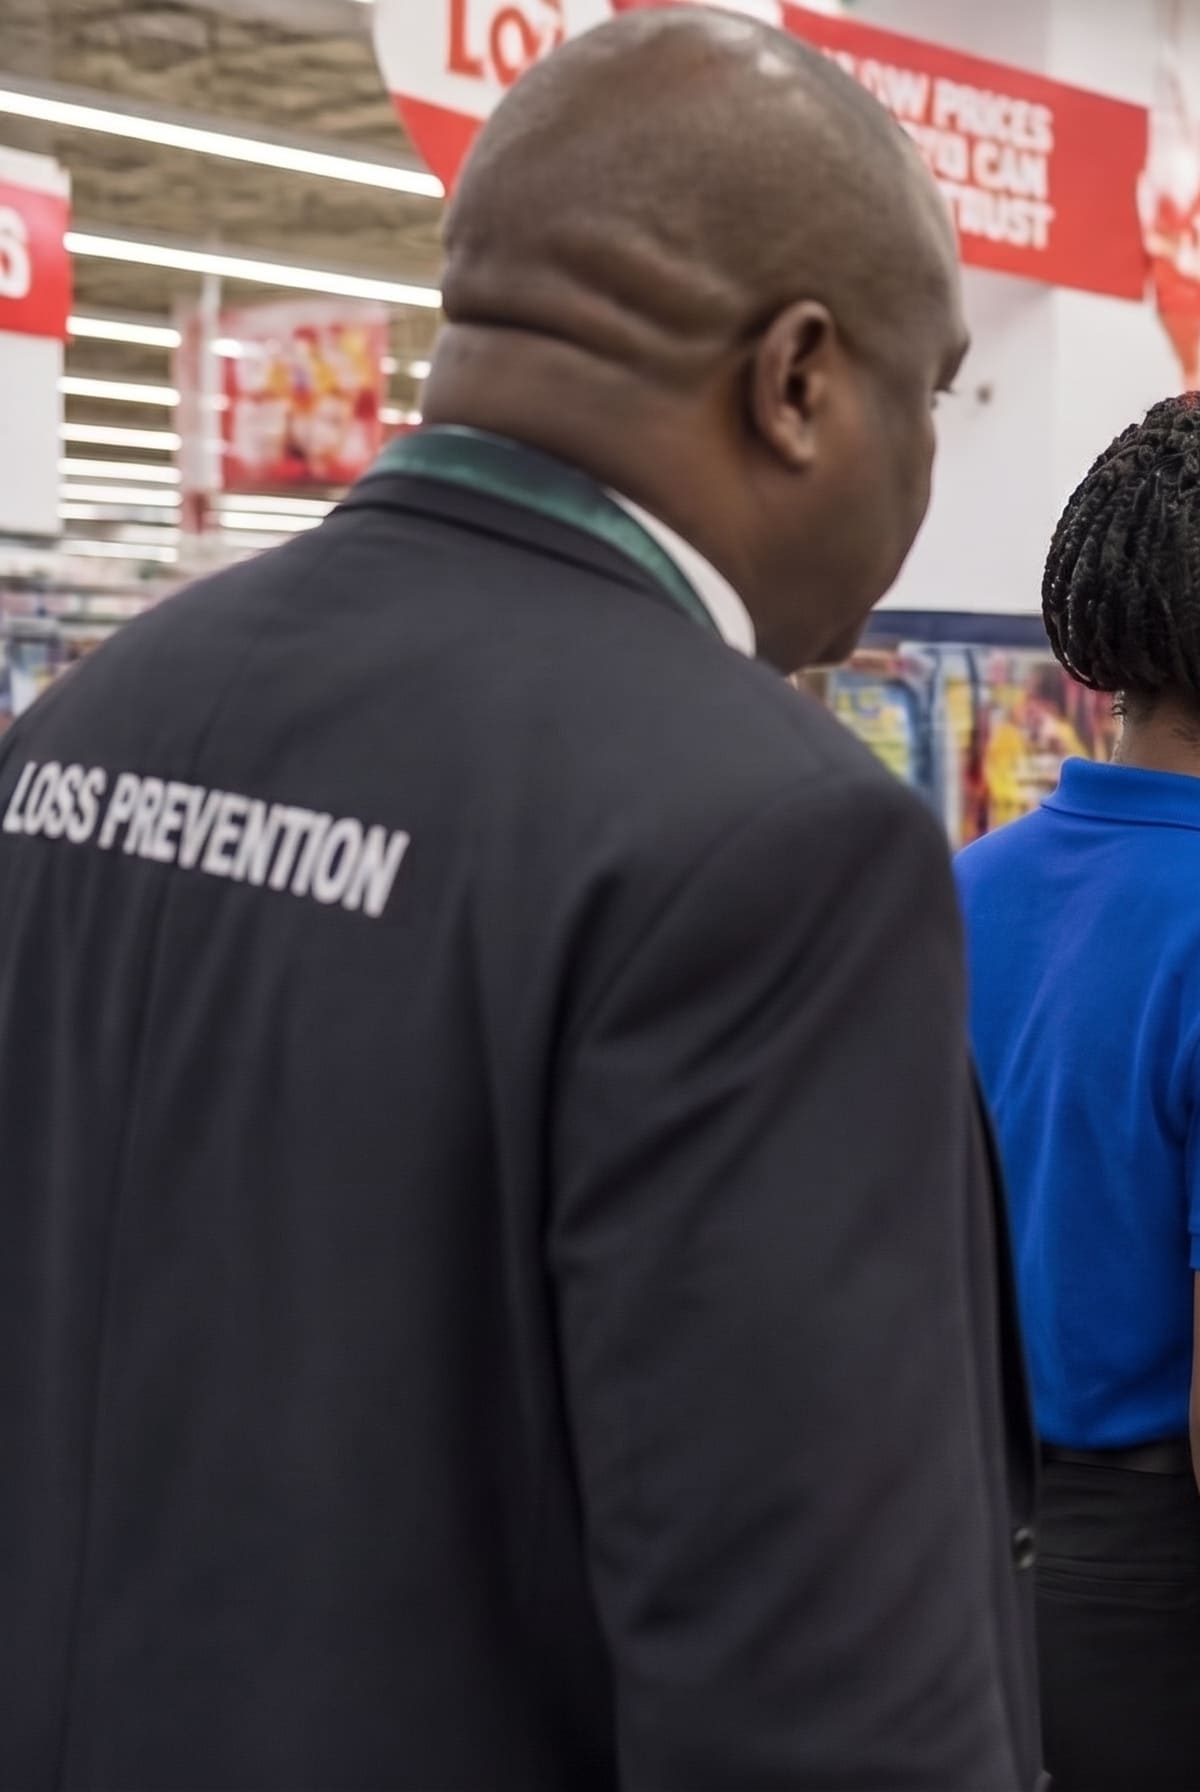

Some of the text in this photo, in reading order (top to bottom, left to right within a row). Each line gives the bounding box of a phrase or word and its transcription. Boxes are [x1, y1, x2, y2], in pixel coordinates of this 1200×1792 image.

[931, 75, 1055, 155] PRICES
[972, 138, 1048, 200] CAN
[3, 760, 411, 918] LOSS PREVENTION
